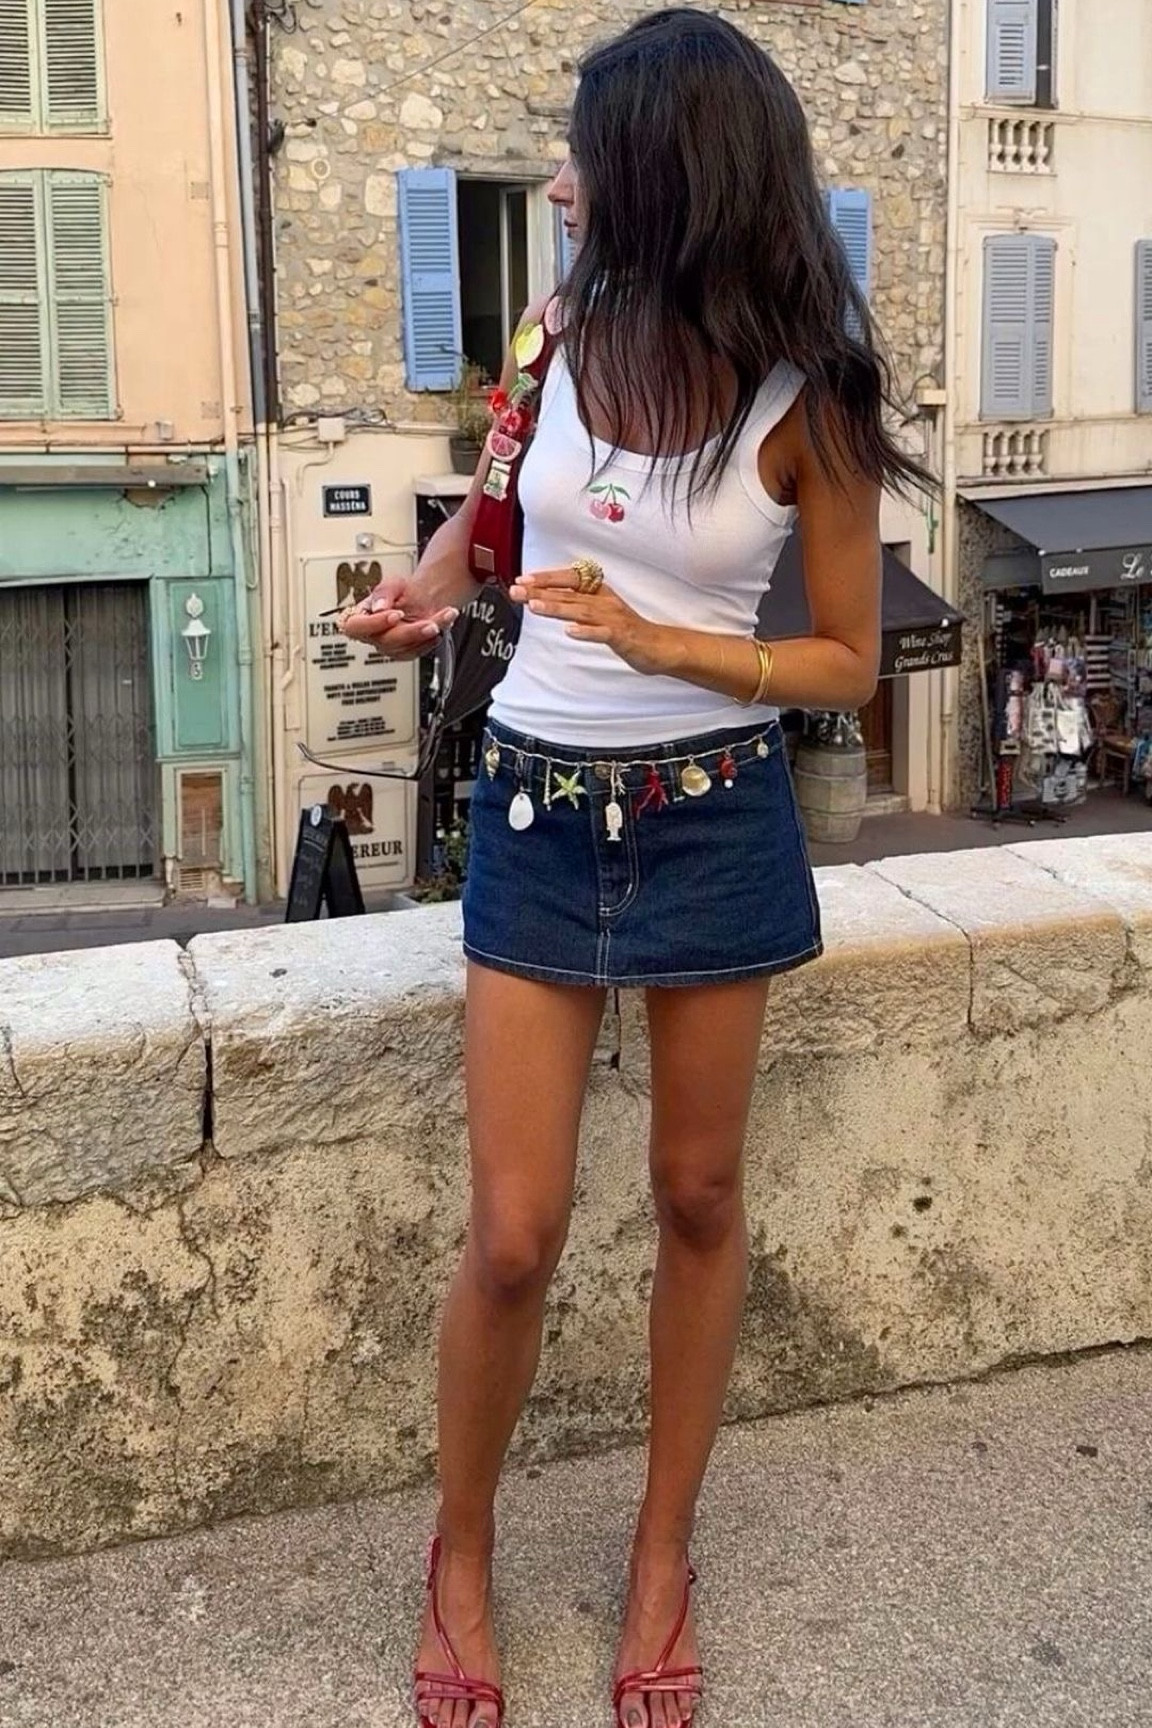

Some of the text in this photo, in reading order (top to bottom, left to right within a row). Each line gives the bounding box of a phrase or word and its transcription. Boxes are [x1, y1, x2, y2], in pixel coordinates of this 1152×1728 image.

[1049, 566, 1089, 578] CADEAUX
[481, 628, 514, 660] Sho
[352, 840, 403, 859] EREUR
